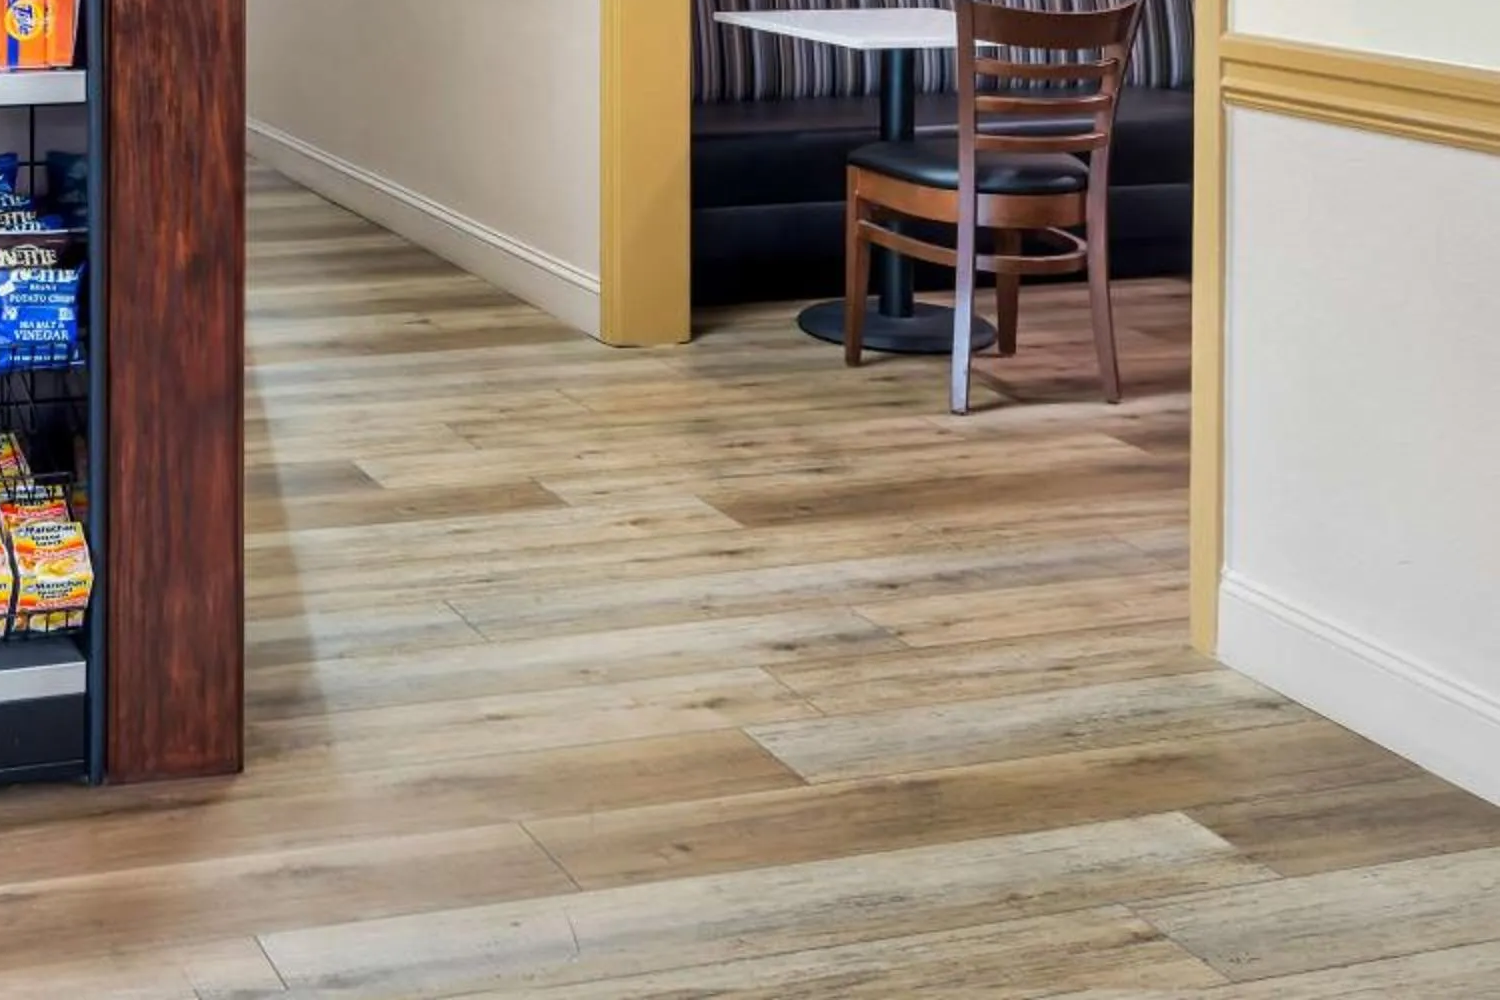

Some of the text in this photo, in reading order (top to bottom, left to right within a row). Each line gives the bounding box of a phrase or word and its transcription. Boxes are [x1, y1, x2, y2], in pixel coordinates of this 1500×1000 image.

[13, 4, 35, 36] Tide
[13, 329, 69, 341] VINEGAR
[34, 579, 87, 590] Maruchan
